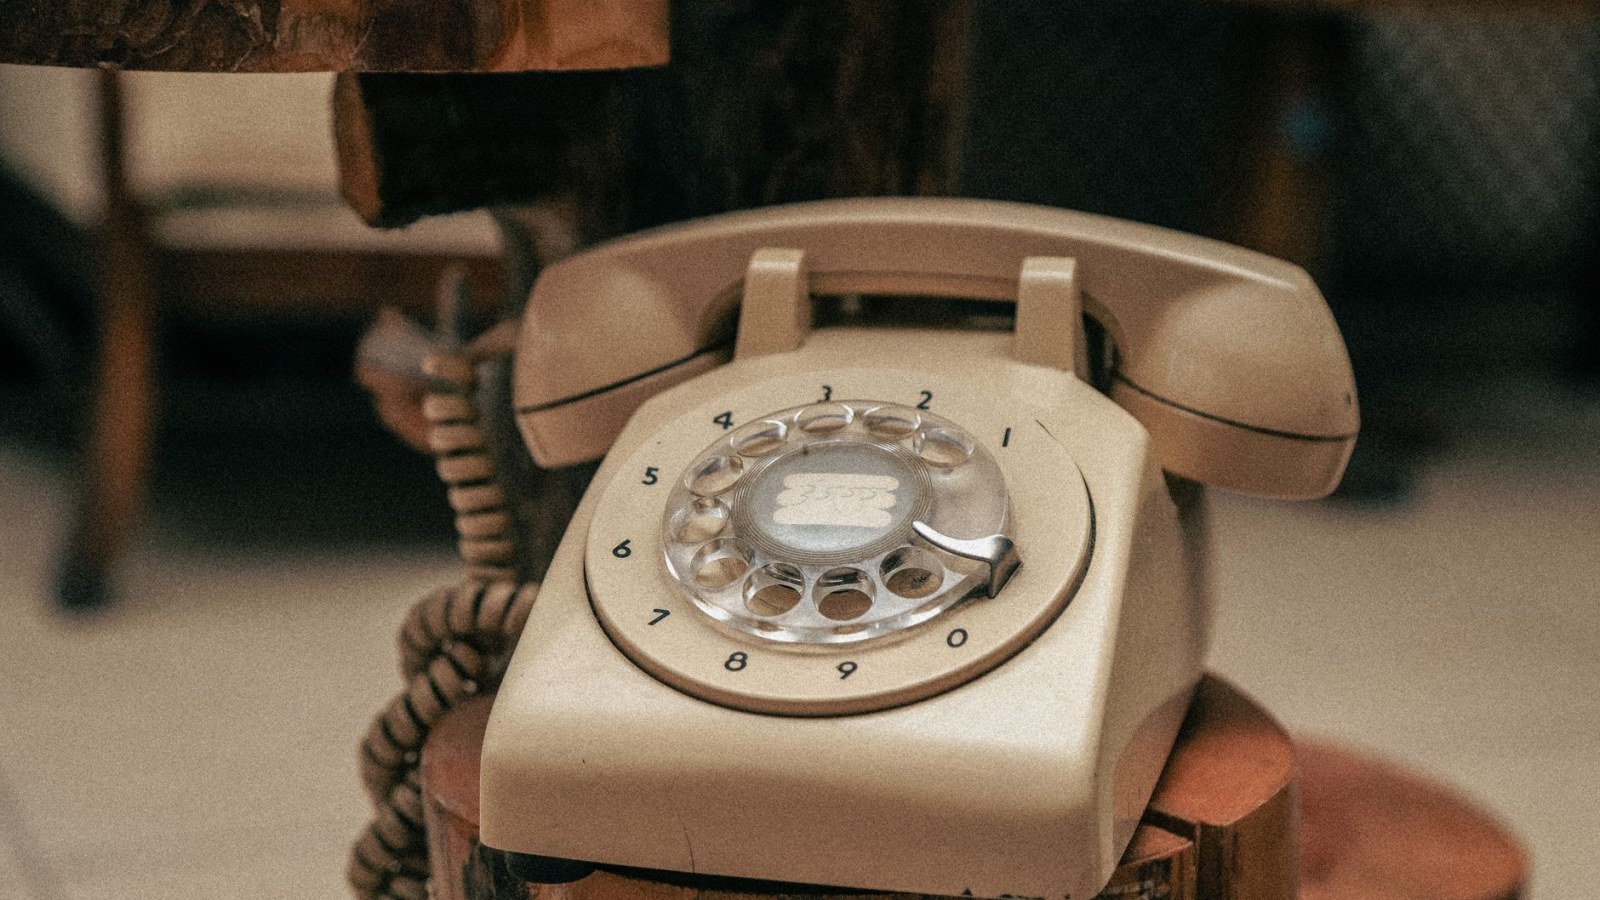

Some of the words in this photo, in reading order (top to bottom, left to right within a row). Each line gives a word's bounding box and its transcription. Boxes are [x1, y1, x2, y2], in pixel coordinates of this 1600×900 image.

[820, 385, 832, 403] 3
[917, 391, 933, 410] 2
[713, 411, 733, 430] 4
[1003, 427, 1011, 447] 1
[642, 467, 659, 485] 5
[613, 540, 631, 559] 6
[648, 609, 671, 626] 7
[724, 652, 747, 672] 8
[837, 661, 857, 680] 9
